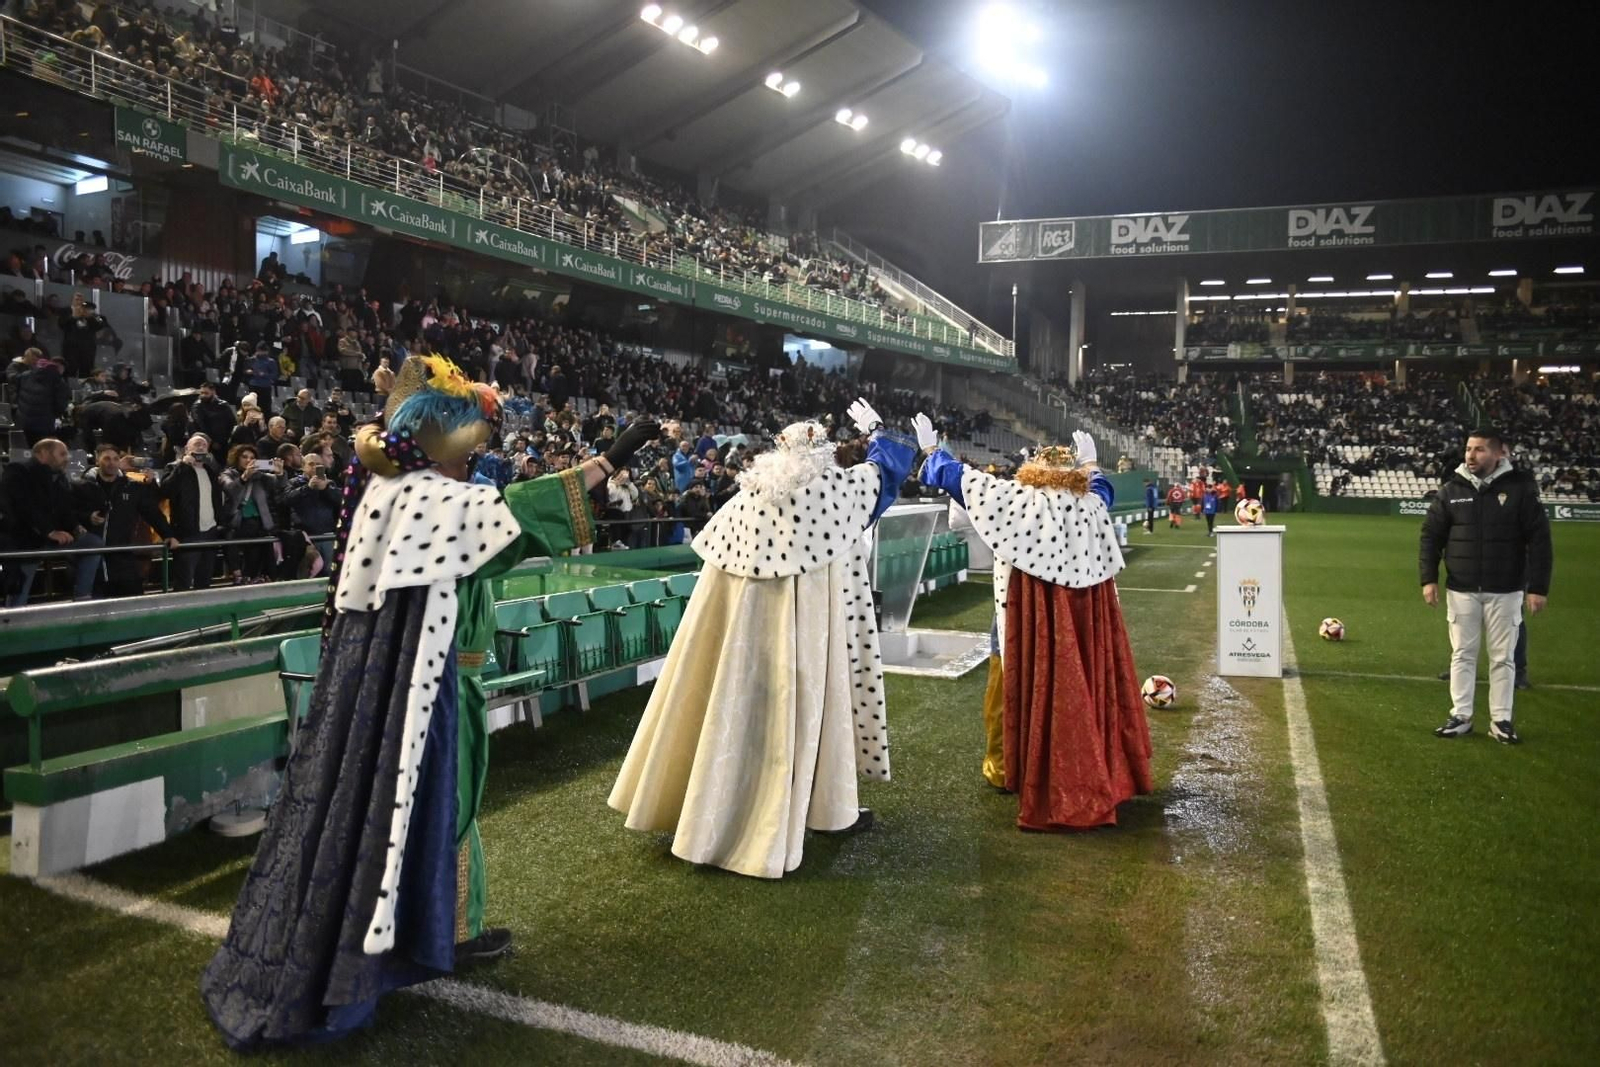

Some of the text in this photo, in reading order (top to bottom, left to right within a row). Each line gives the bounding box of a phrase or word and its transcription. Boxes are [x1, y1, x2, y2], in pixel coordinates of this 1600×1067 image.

[117, 129, 183, 159] SAN RAFAEL
[264, 168, 336, 204] CaixaBank
[389, 204, 447, 234] CaixaBank
[1287, 205, 1376, 237] DIAZ
[1493, 192, 1595, 226] DIAZ
[1042, 230, 1070, 248] RG3
[1111, 215, 1190, 244] DIAZ
[1287, 235, 1374, 248] food solutions
[1493, 224, 1592, 238] food solutions
[490, 232, 539, 259] CaixaBank
[1111, 242, 1189, 255] food solutions
[574, 257, 616, 279] CaixaBank
[753, 302, 826, 329] Supermercados
[867, 330, 926, 352] Supermercados
